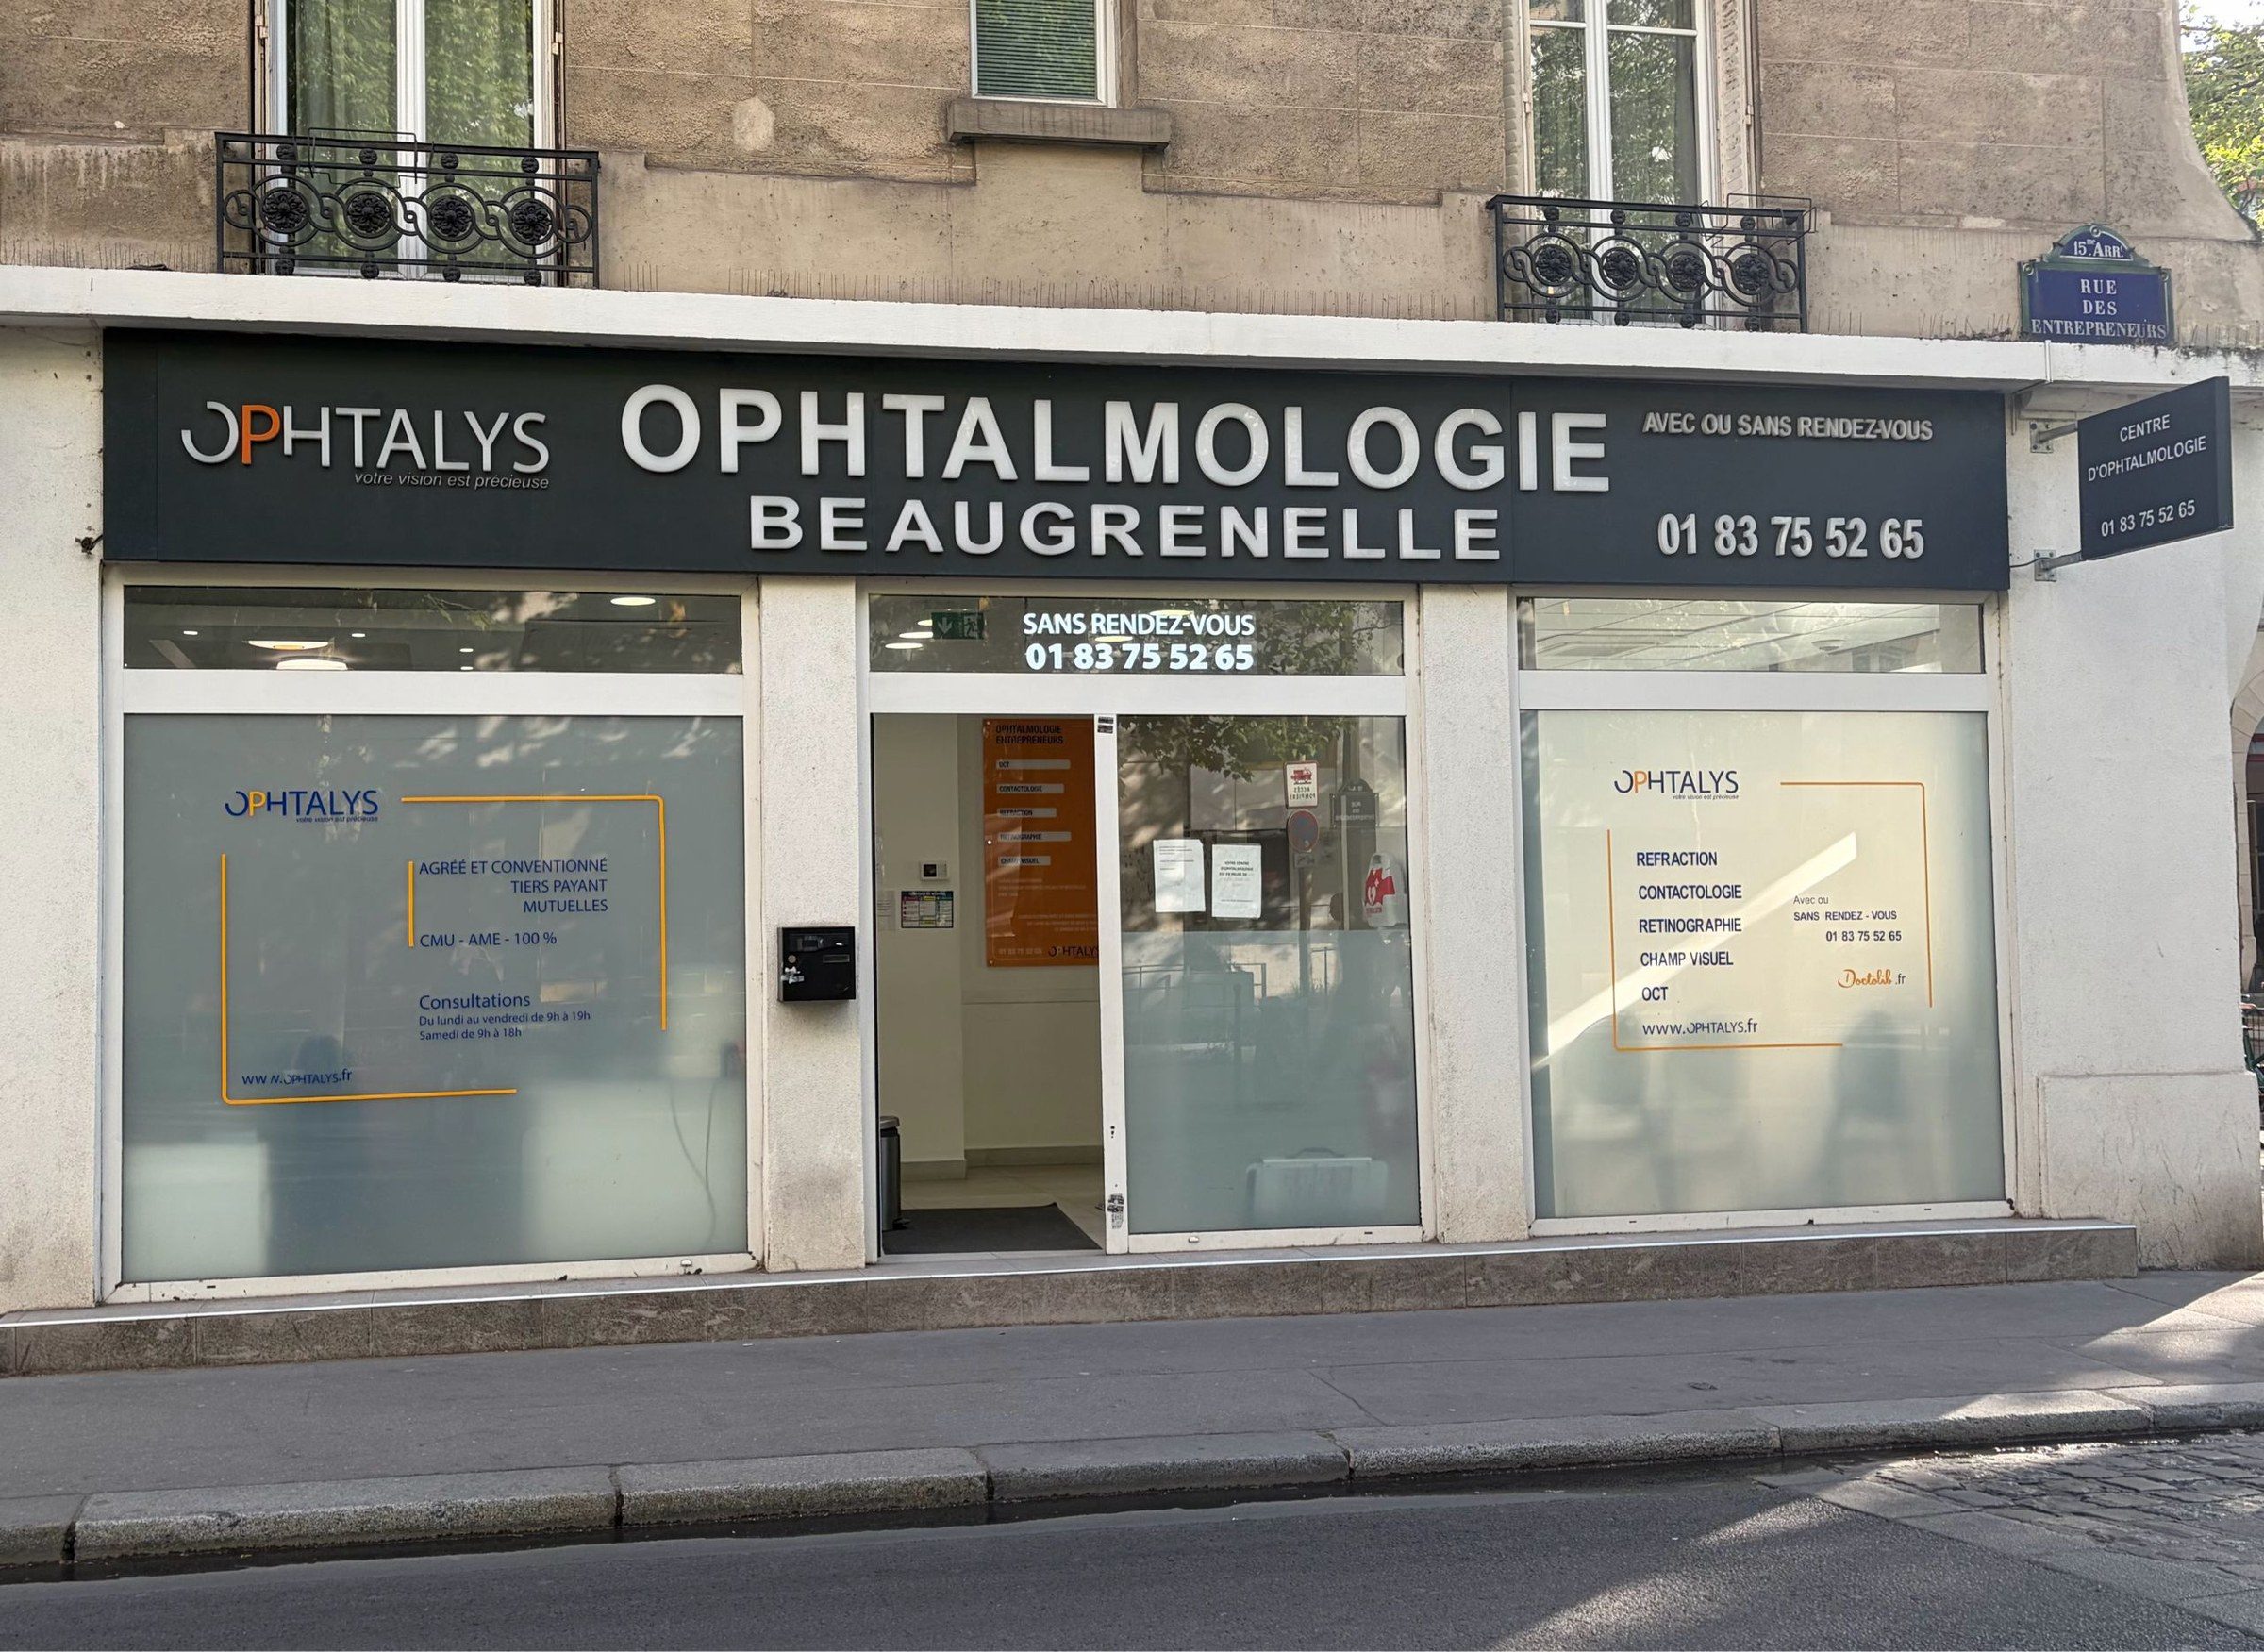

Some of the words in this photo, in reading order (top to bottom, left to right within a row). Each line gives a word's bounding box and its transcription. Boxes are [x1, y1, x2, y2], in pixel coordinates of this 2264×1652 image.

[2080, 278, 2117, 295] RUE
[2083, 299, 2117, 315] DES
[2031, 319, 2167, 339] ENTREPRENEURS
[1642, 412, 1695, 434] AVEC
[1701, 413, 1732, 436] OU
[1737, 414, 1792, 437] SANS
[1797, 416, 1934, 441] RENDEZ-VOUS
[2120, 414, 2171, 442] CENTRE
[180, 400, 550, 473] OPHTALYS
[621, 383, 1609, 492] OPHTALMOLOGIE
[2088, 435, 2207, 481] D'OPHTALMOLOGIE
[355, 473, 393, 485] votre
[398, 473, 442, 486] vision
[447, 475, 471, 487] est
[474, 474, 550, 490] précieuse
[2101, 519, 2115, 537] 01
[2120, 514, 2136, 532] 83
[2139, 509, 2155, 527] 75
[2158, 505, 2174, 523] 52
[2178, 499, 2196, 518] 65
[750, 495, 1501, 561] BEAUGRENELLE
[1657, 513, 1697, 556] 01
[1714, 514, 1759, 557] 83
[1771, 516, 1813, 557] 75
[1825, 517, 1868, 558] 52
[1880, 518, 1924, 559] 65
[1023, 612, 1087, 635] SANS
[1090, 613, 1256, 637] RENDEZ-VOUS
[1025, 643, 1064, 670] 01
[1074, 643, 1114, 670] 83
[1122, 643, 1162, 670] 75
[1169, 643, 1208, 670] 52
[1214, 643, 1255, 670] 65
[996, 725, 1062, 734] OPHTALMOLOGIE
[1613, 770, 1739, 793] OPHTALYS
[225, 790, 379, 817] OPHTALYS
[419, 859, 467, 875] AGRÉÉ
[471, 860, 489, 874] ET
[491, 857, 608, 874] CONVENTIONNÉ
[1637, 851, 1718, 867] REFRACTION
[510, 879, 549, 893] TIERS
[554, 878, 608, 893] PAYANT
[1639, 884, 1742, 900] CONTACTOLOGIE
[524, 898, 608, 913] MUTUELLES
[1793, 895, 1815, 905] Avec
[1817, 895, 1829, 905] ou
[1793, 911, 1820, 922] SANS
[1824, 911, 1864, 921] RENDEZ
[1871, 910, 1898, 920] VOUS
[1639, 917, 1742, 934] RETINOGRAPHIE
[420, 934, 455, 947] CMU
[468, 932, 501, 946] AME
[514, 932, 540, 945] 100
[542, 931, 557, 944] %
[1825, 930, 1838, 942] 01
[1841, 930, 1856, 942] 83
[1857, 930, 1871, 942] 75
[1873, 930, 1887, 942] 52
[1889, 930, 1902, 942] 65
[1640, 952, 1686, 967] CHAMP
[1690, 951, 1734, 967] VISUEL
[419, 993, 531, 1010] Consultations
[1641, 986, 1669, 1002] OCT
[419, 1015, 434, 1026] Du
[437, 1014, 464, 1025] lundi
[466, 1016, 479, 1025] au
[482, 1012, 528, 1024] vendredi
[531, 1011, 544, 1022] de
[547, 1010, 560, 1022] 9h
[562, 1011, 569, 1021] à
[572, 1010, 591, 1021] 19h
[419, 1029, 459, 1041] Samedi
[461, 1028, 474, 1039] de
[477, 1027, 491, 1039] 9h
[493, 1027, 500, 1038] à
[503, 1027, 522, 1037] 18h
